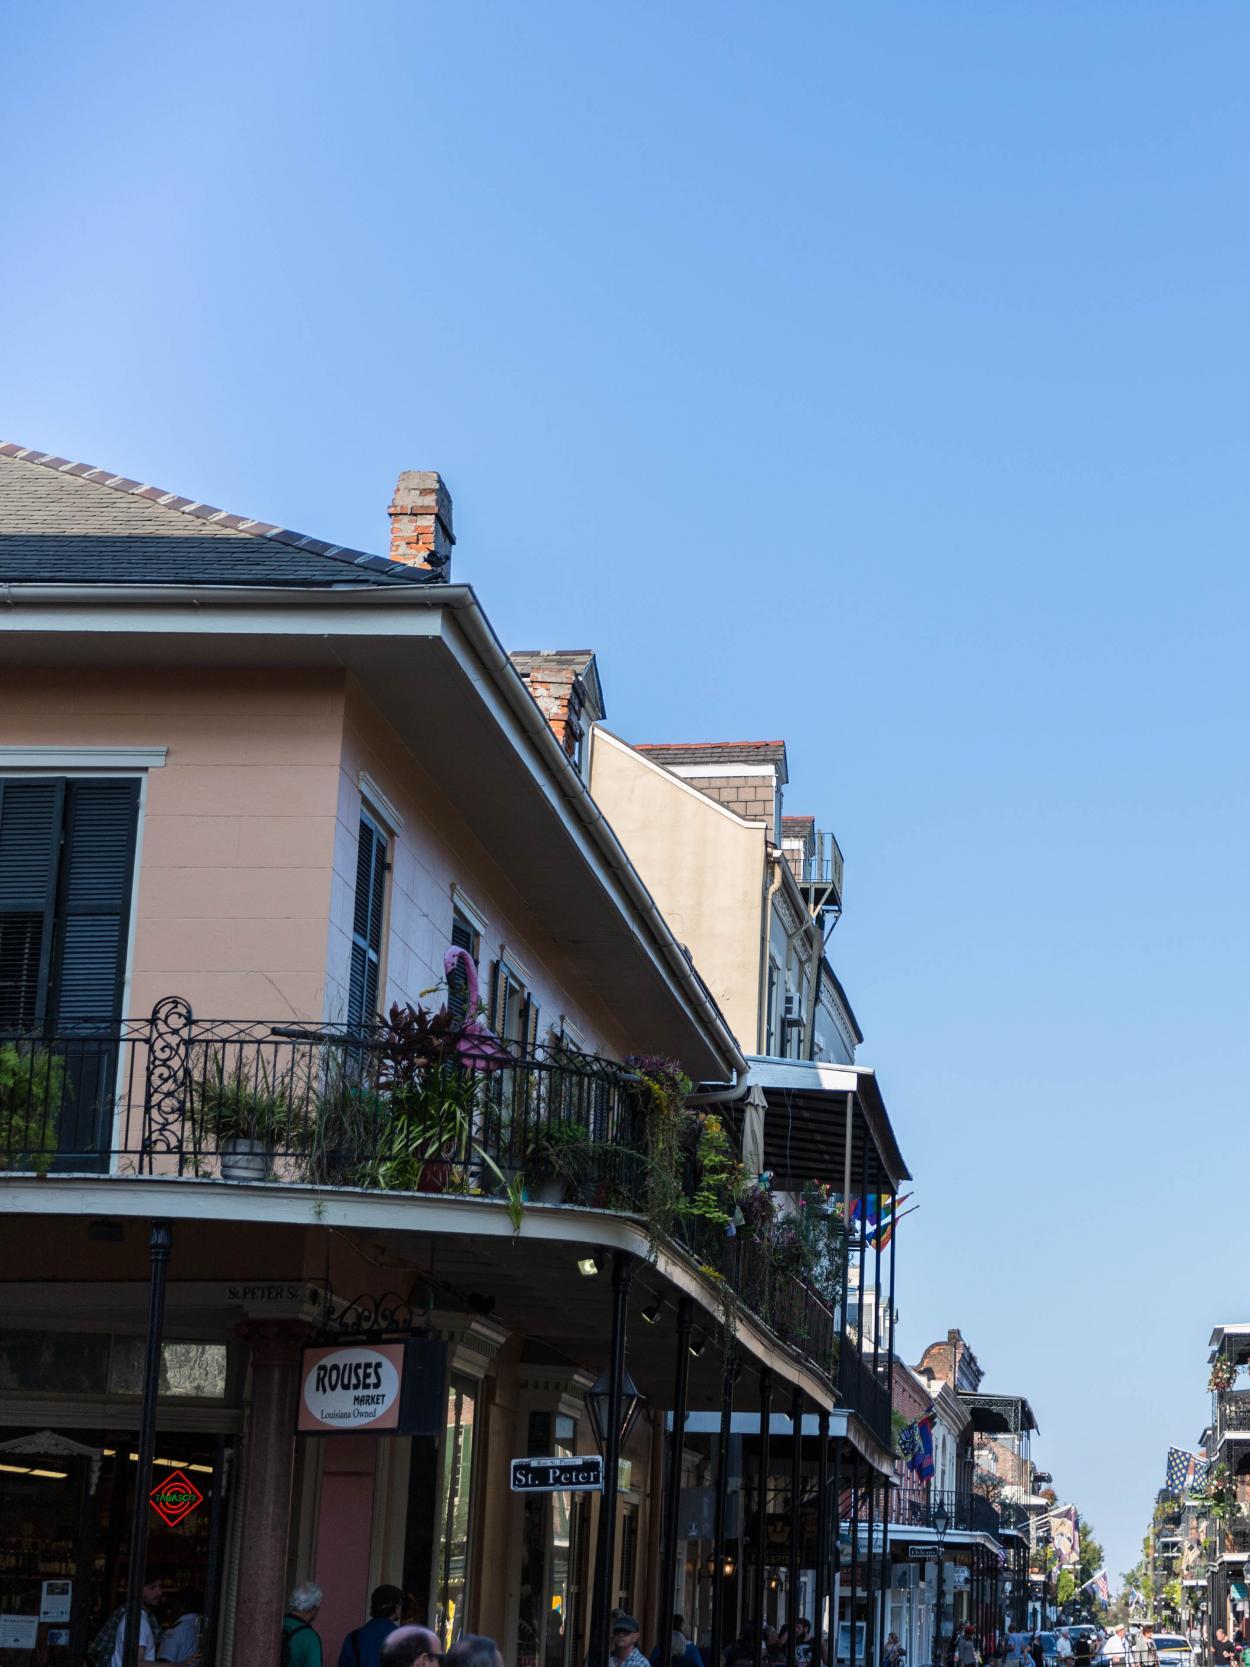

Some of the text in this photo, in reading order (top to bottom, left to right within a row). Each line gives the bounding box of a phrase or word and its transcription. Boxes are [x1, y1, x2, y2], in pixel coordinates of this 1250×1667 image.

[243, 1287, 284, 1299] PETER
[316, 1361, 383, 1394] ROUSES
[353, 1394, 386, 1406] MARKET
[321, 1407, 377, 1419] Louisiana Owned
[515, 1468, 597, 1485] St. Peter
[911, 1547, 936, 1556] Orleans
